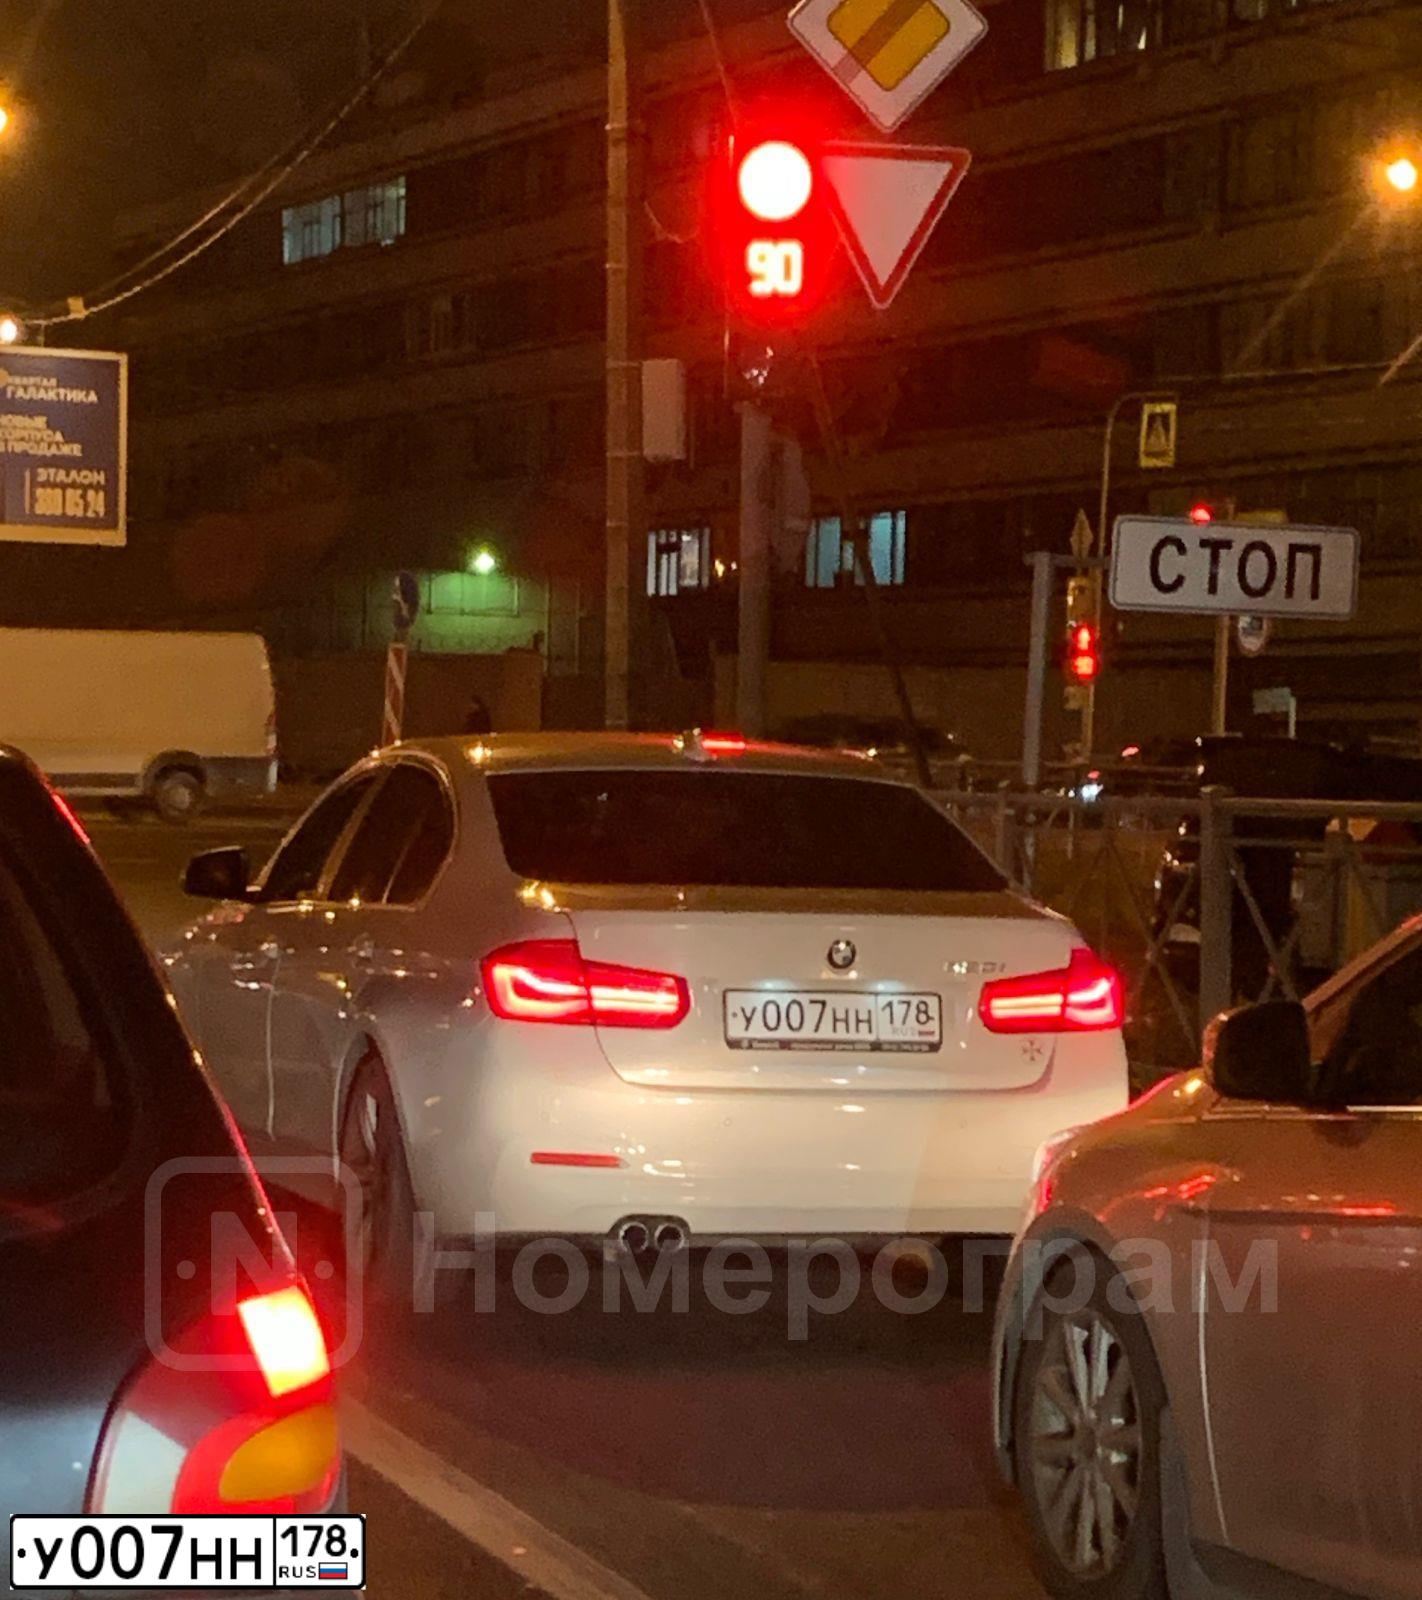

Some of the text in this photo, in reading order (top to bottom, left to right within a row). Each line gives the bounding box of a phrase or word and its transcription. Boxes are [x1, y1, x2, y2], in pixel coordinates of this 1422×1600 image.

[745, 239, 804, 297] 90
[6, 386, 98, 403] ГАЛАКТИКА
[37, 468, 105, 485] ЭТАЛОН
[1150, 535, 1322, 600] СТОП
[881, 1000, 929, 1026] 178
